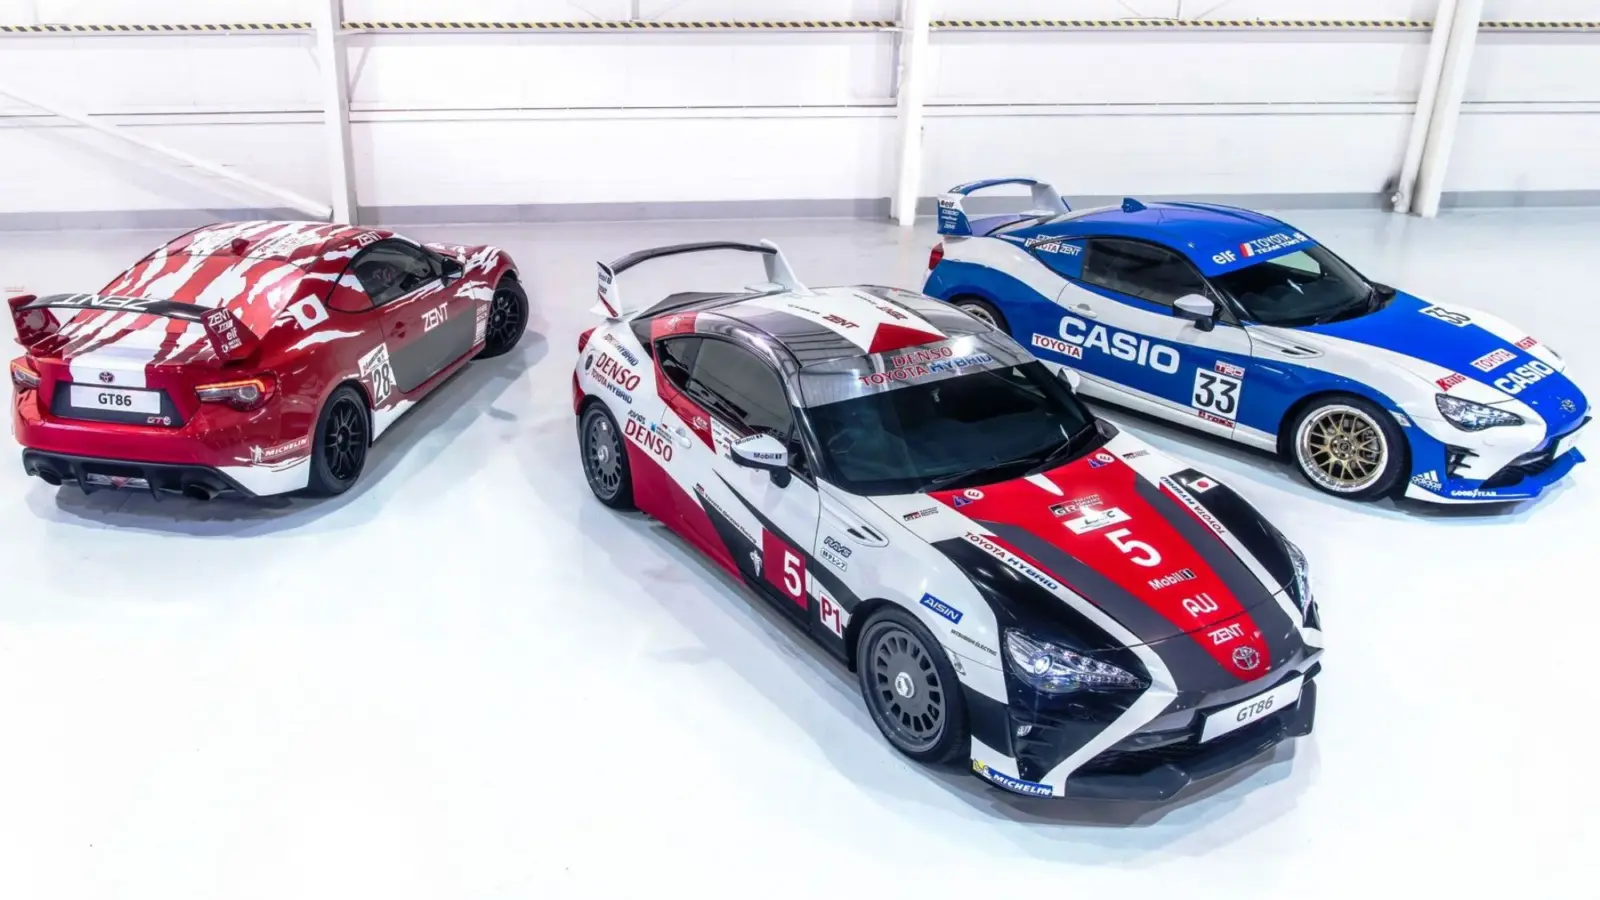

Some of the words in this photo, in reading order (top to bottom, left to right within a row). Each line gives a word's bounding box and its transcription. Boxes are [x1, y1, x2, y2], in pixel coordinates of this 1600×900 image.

[355, 231, 383, 247] ZENT
[1251, 233, 1292, 249] TOYOTA
[1212, 250, 1236, 265] elf
[207, 309, 231, 327] ZENT
[422, 302, 448, 332] ZENT
[822, 314, 860, 329] ZENT
[1425, 307, 1472, 324] 33
[226, 327, 238, 341] elf
[1059, 316, 1180, 374] CASIO
[891, 346, 953, 369] DENSO
[1034, 335, 1080, 357] TOYOTA
[595, 352, 641, 392] DENSO
[859, 364, 928, 388] TOYOTA
[928, 353, 993, 374] HYBRID
[1474, 351, 1513, 370] TOYOTA
[373, 363, 390, 406] 28
[1494, 361, 1555, 394] CASIO
[98, 392, 132, 406] GT86
[606, 383, 633, 405] HYBRID
[1195, 372, 1238, 414] 33
[265, 439, 307, 457] MICHELIN
[625, 418, 673, 462] DENSO
[1411, 475, 1442, 489] adidas
[1194, 505, 1226, 534] TOYOTA
[824, 535, 852, 558] RAYS
[1104, 529, 1162, 567] 5
[965, 531, 1006, 559] TOYOTA
[1006, 557, 1059, 591] HYBRID
[784, 550, 801, 597] 5
[1148, 573, 1184, 591] Mobil
[821, 595, 841, 633] P1
[924, 599, 959, 621] AISIN
[1207, 623, 1245, 646] ZENT
[1236, 695, 1274, 722] GT86
[993, 773, 1052, 796] MICHELIN
